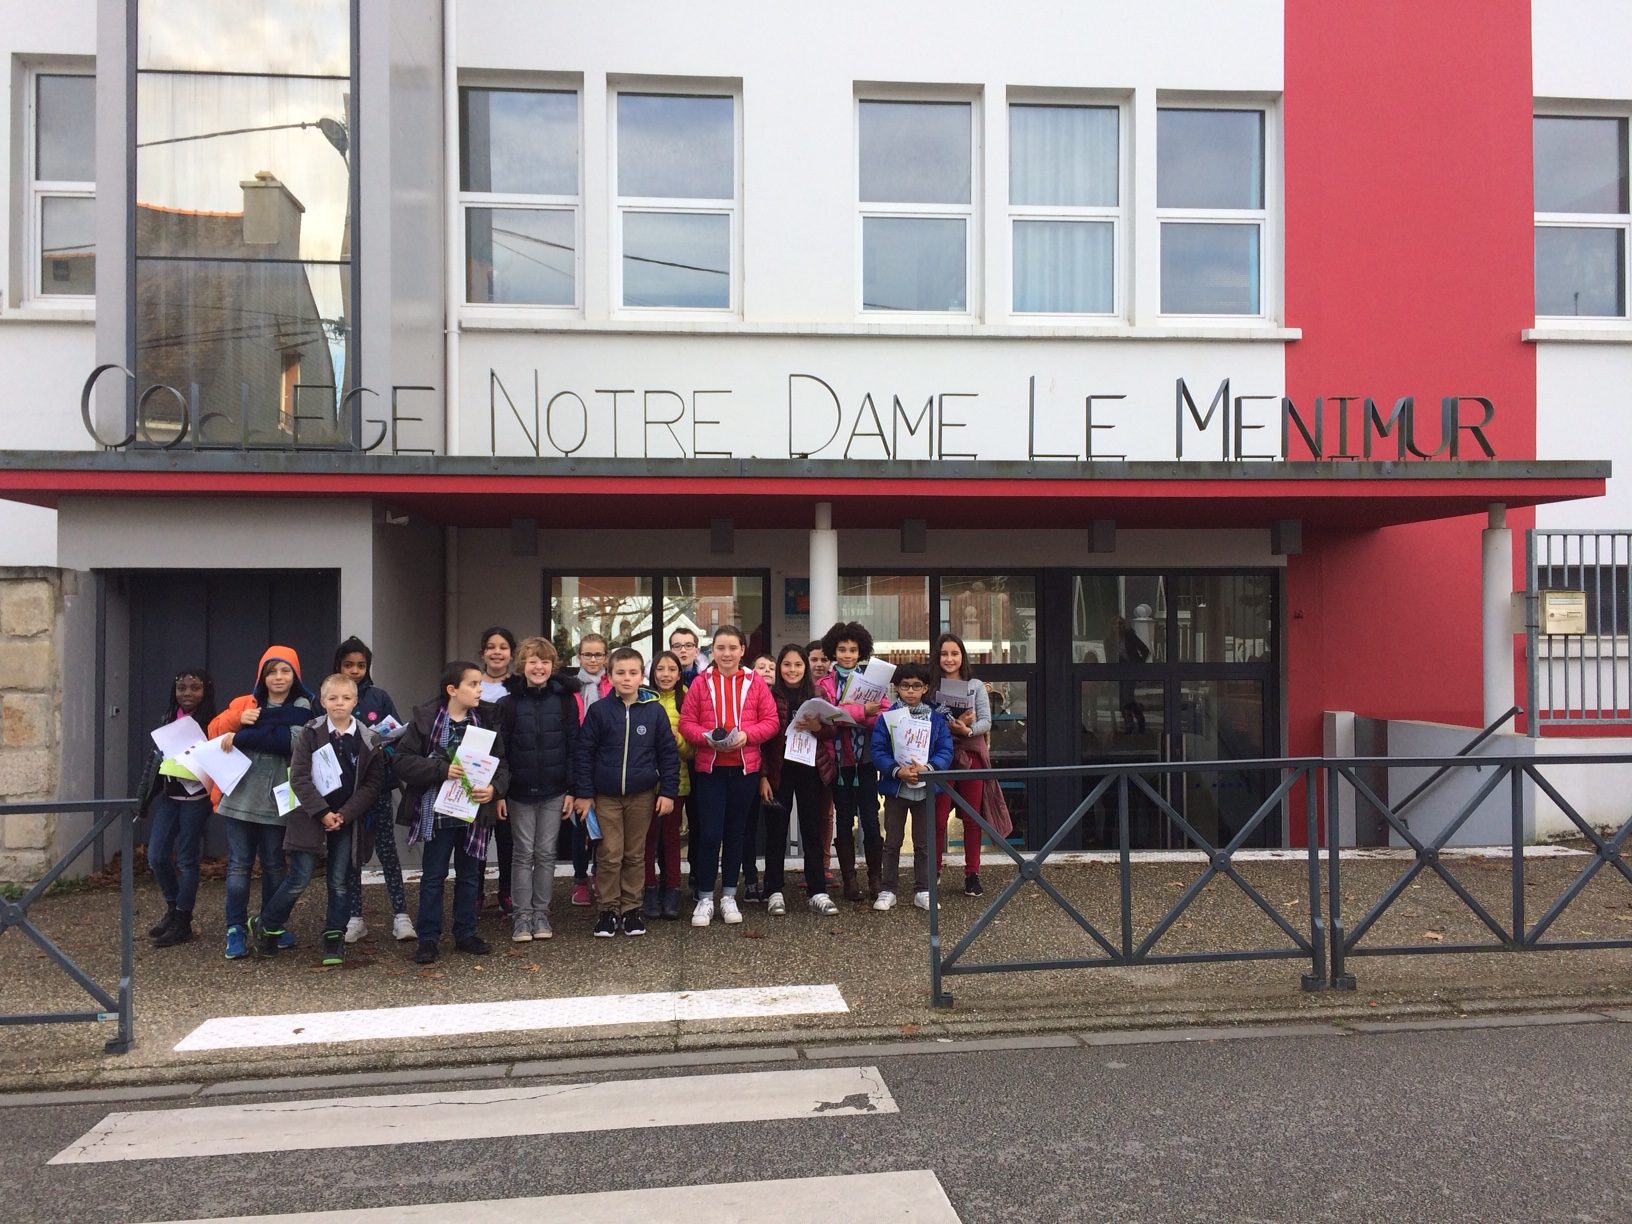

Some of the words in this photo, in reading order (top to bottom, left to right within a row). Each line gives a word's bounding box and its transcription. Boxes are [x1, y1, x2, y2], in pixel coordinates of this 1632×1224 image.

[81, 363, 436, 455] COLLEGE
[490, 367, 733, 458] NOTRE
[788, 373, 979, 460] DAME
[1028, 374, 1128, 461] LE
[1175, 376, 1497, 462] MENIMUR
